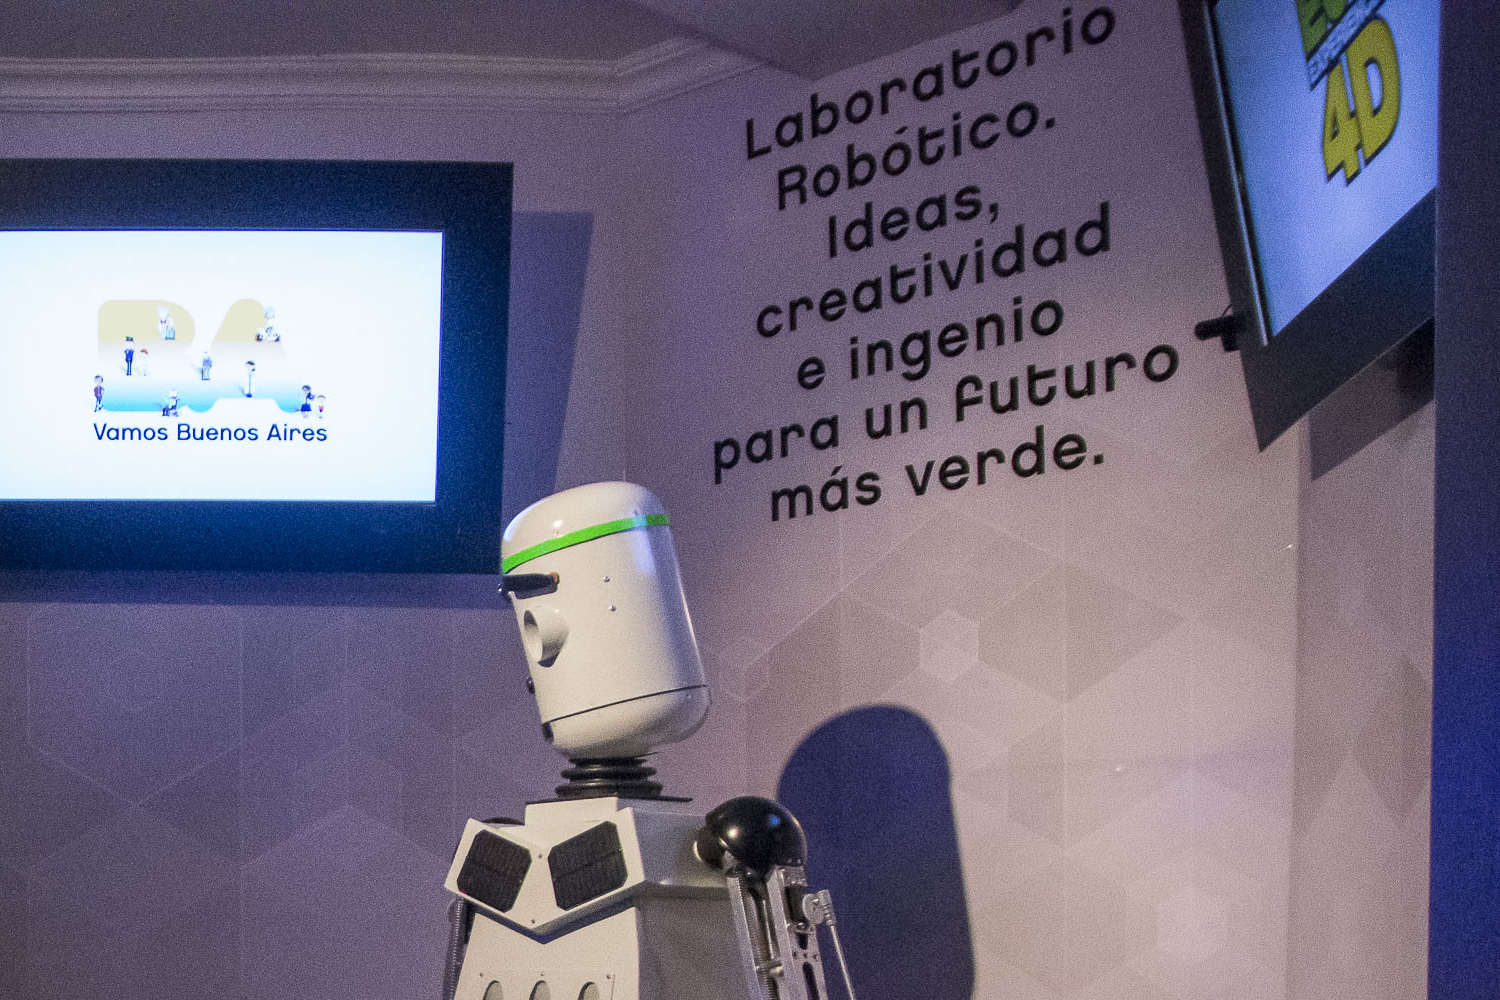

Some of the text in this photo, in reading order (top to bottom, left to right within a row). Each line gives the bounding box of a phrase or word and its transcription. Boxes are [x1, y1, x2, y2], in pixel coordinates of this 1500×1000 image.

[746, 5, 1116, 160] Laboratorio
[1322, 15, 1401, 187] 4D
[777, 101, 1056, 210] Robótico.
[756, 200, 1110, 338] creatividad
[829, 185, 999, 258] Ideas,
[798, 296, 1064, 389] e ingenio
[93, 423, 328, 442] Vamos Buenos Aires
[714, 344, 1179, 484] para un futuro
[772, 425, 1104, 521] más verde.
